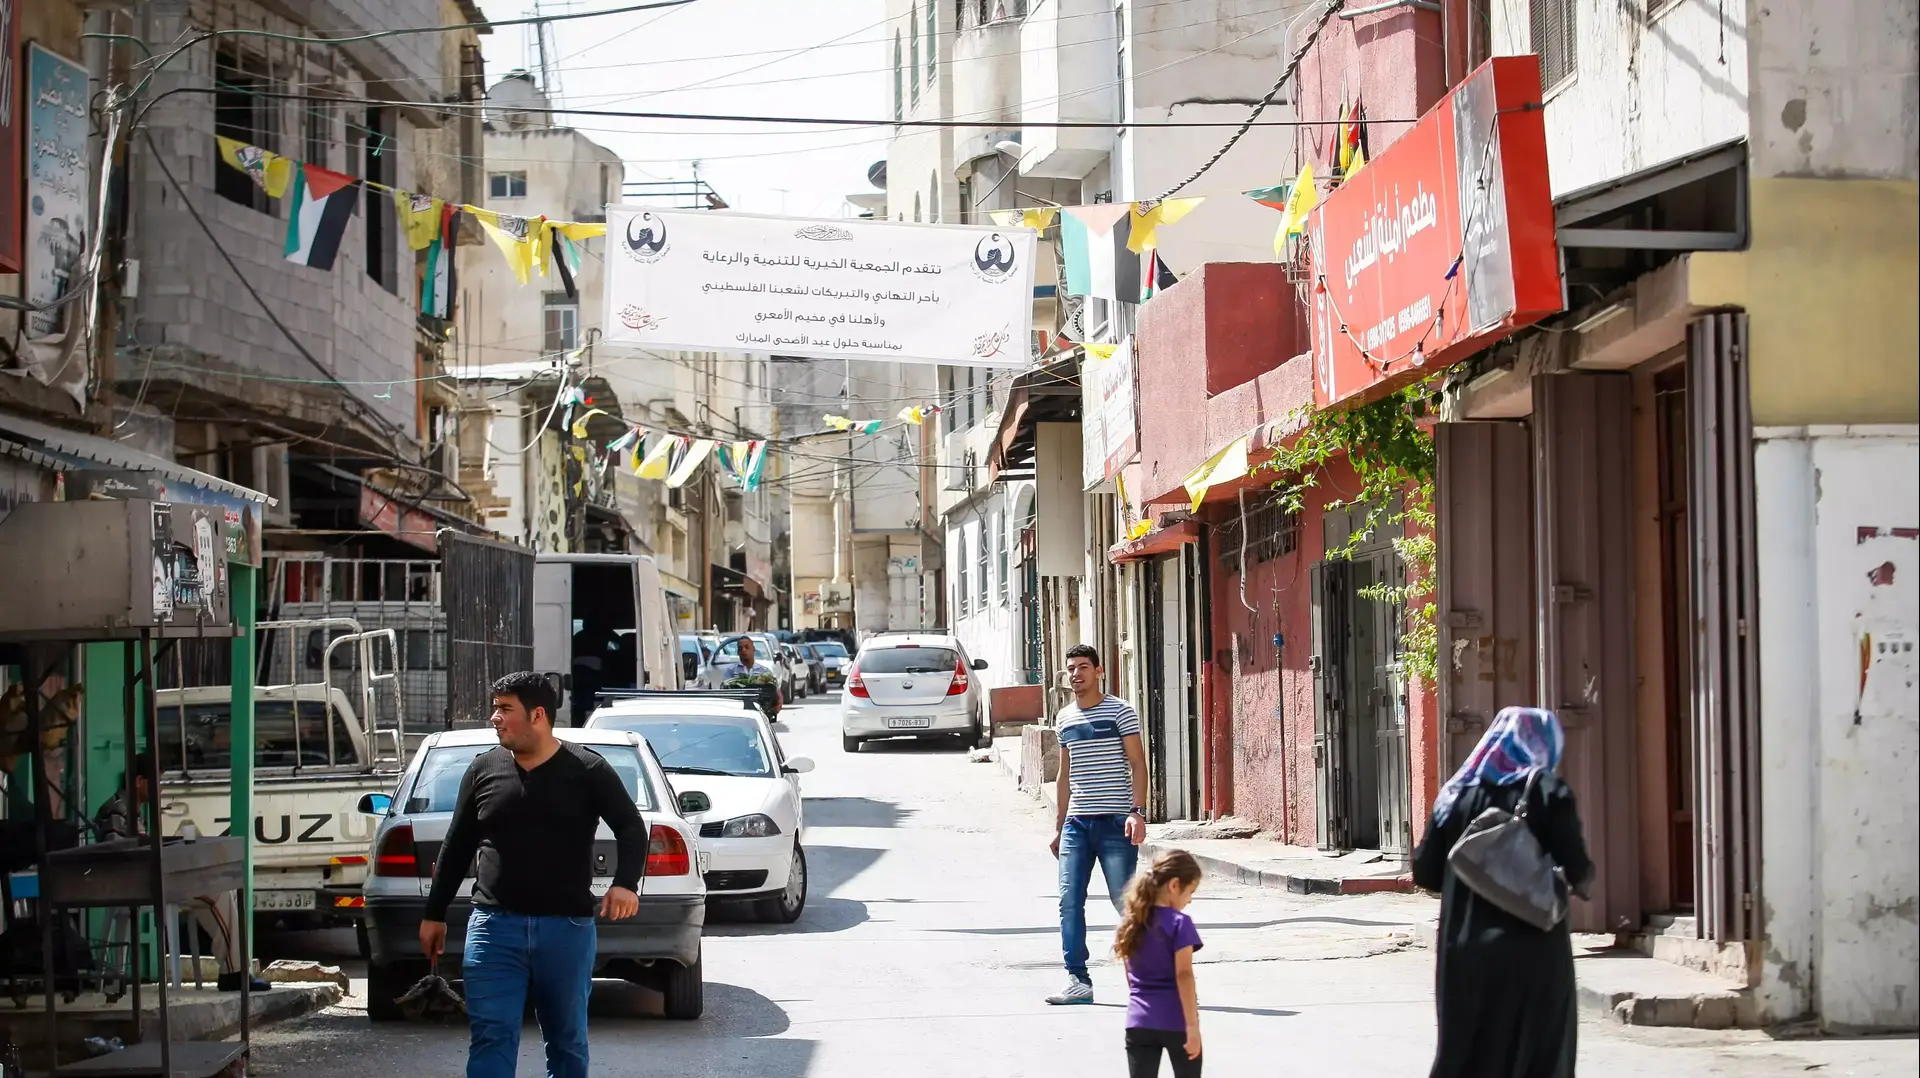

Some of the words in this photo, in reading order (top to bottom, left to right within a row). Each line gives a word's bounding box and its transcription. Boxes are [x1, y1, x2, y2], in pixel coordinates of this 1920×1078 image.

[703, 251, 749, 266] والرعاية
[753, 254, 800, 266] للتنمية
[804, 257, 846, 270] الخيرية
[850, 260, 899, 273] الجمعية
[902, 264, 941, 275] تتقدم
[702, 282, 765, 294] الفلسطيني
[769, 284, 808, 295] لشعبنا
[812, 287, 869, 301] والتبريكات
[873, 291, 914, 304] التهاني
[917, 291, 939, 304] بأحر
[755, 311, 792, 323] الأمعري
[795, 314, 825, 323] مخيم
[829, 313, 845, 327] في
[849, 313, 885, 327] ولأهلنا
[736, 333, 770, 343] المبارك
[773, 334, 808, 345] الأضحى
[833, 338, 859, 349] حلول
[862, 340, 902, 351] بمناسبة
